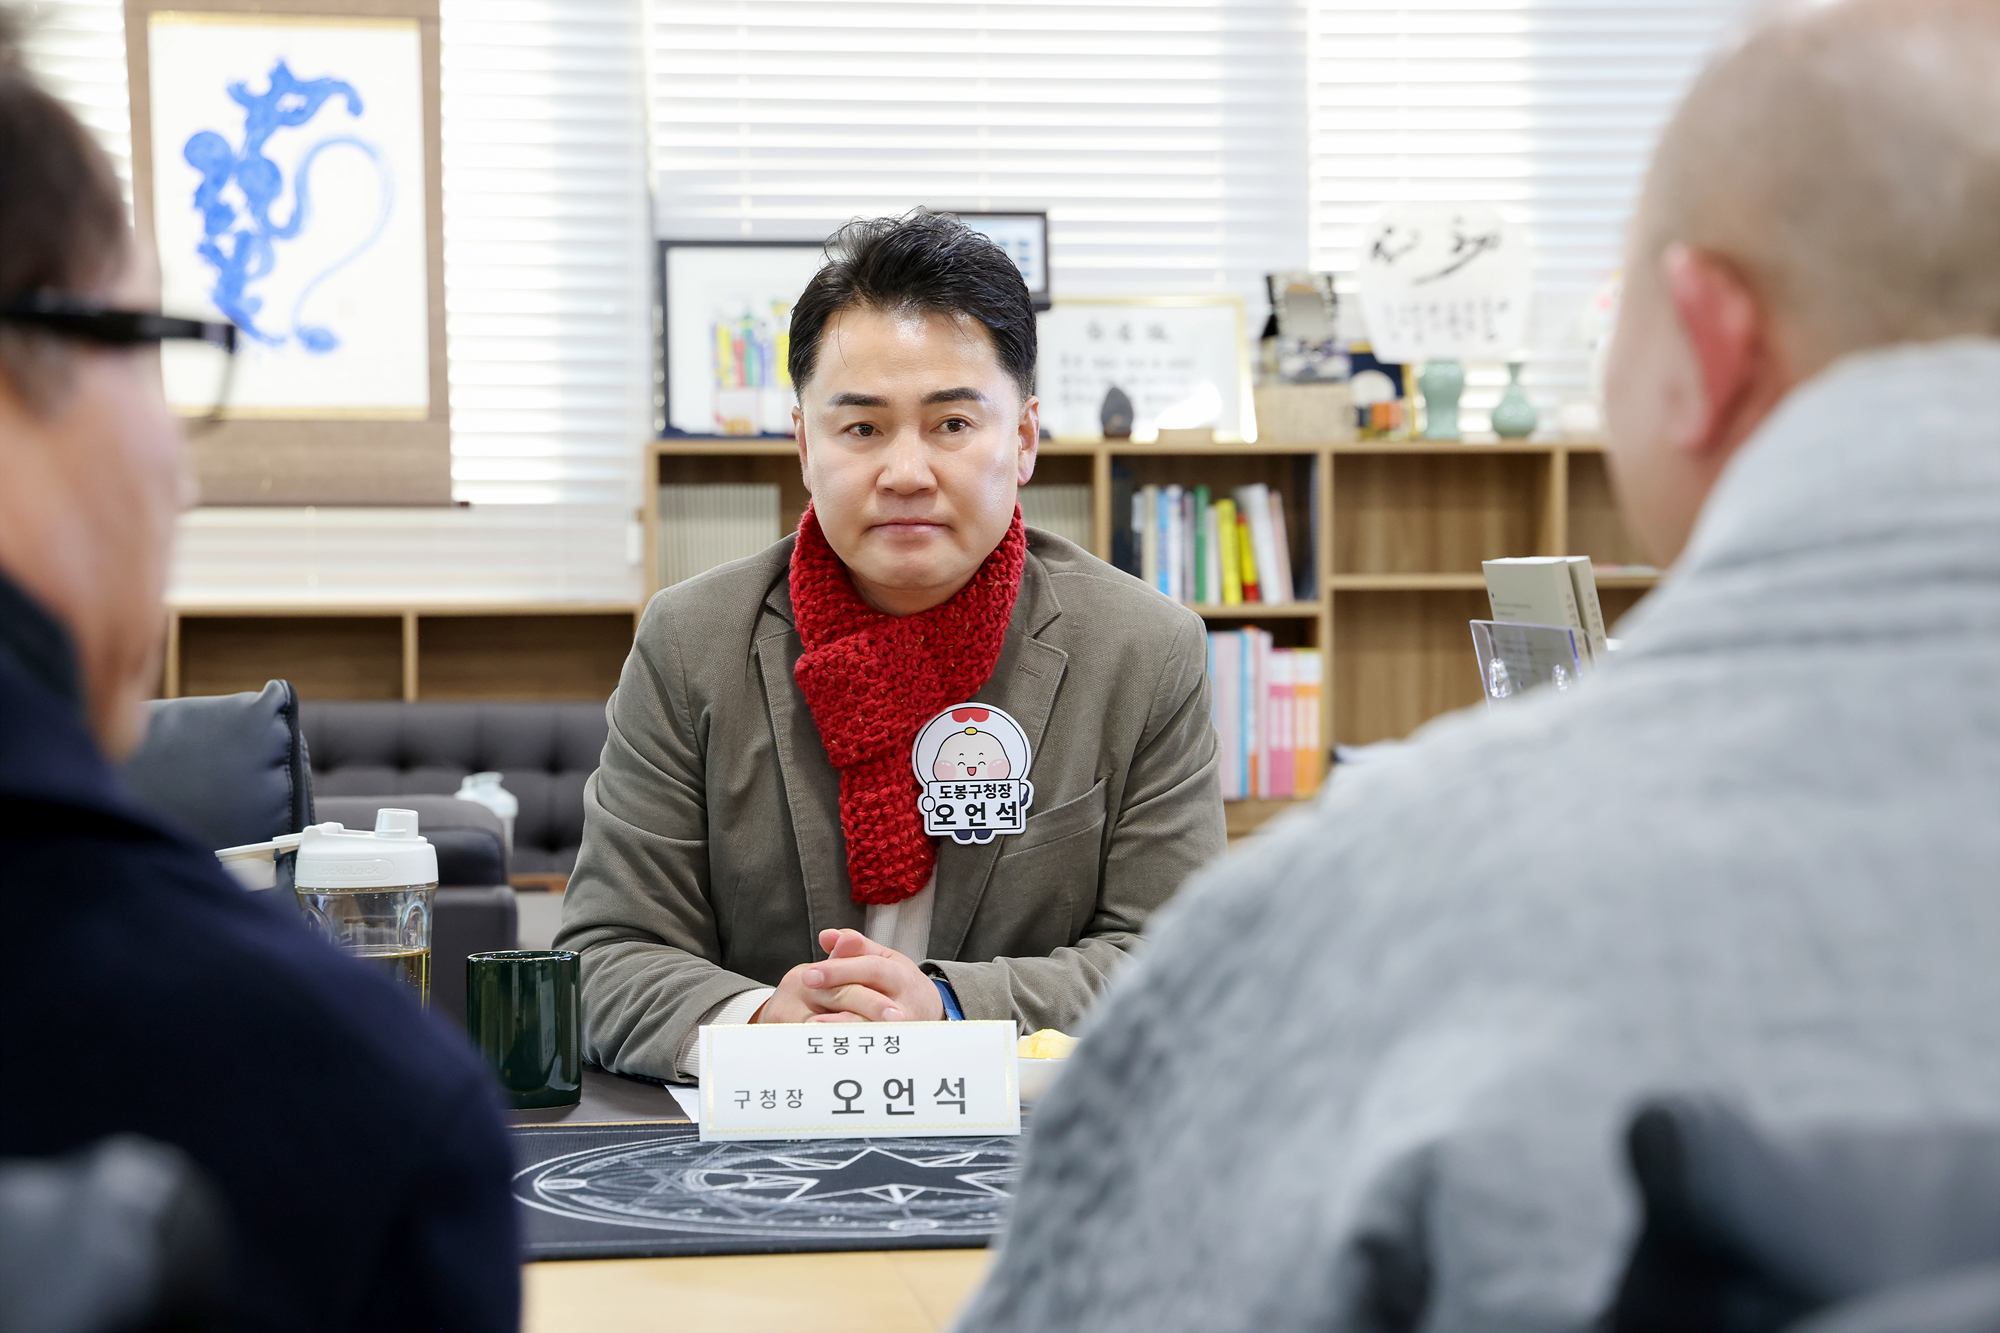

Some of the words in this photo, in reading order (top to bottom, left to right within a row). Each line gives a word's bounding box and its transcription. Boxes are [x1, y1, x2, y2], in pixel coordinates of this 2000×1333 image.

[939, 783, 1012, 800] 도봉구청장
[316, 865, 380, 876] LocknLock
[807, 1035, 902, 1056] 도봉구청
[733, 1088, 804, 1110] 구청장
